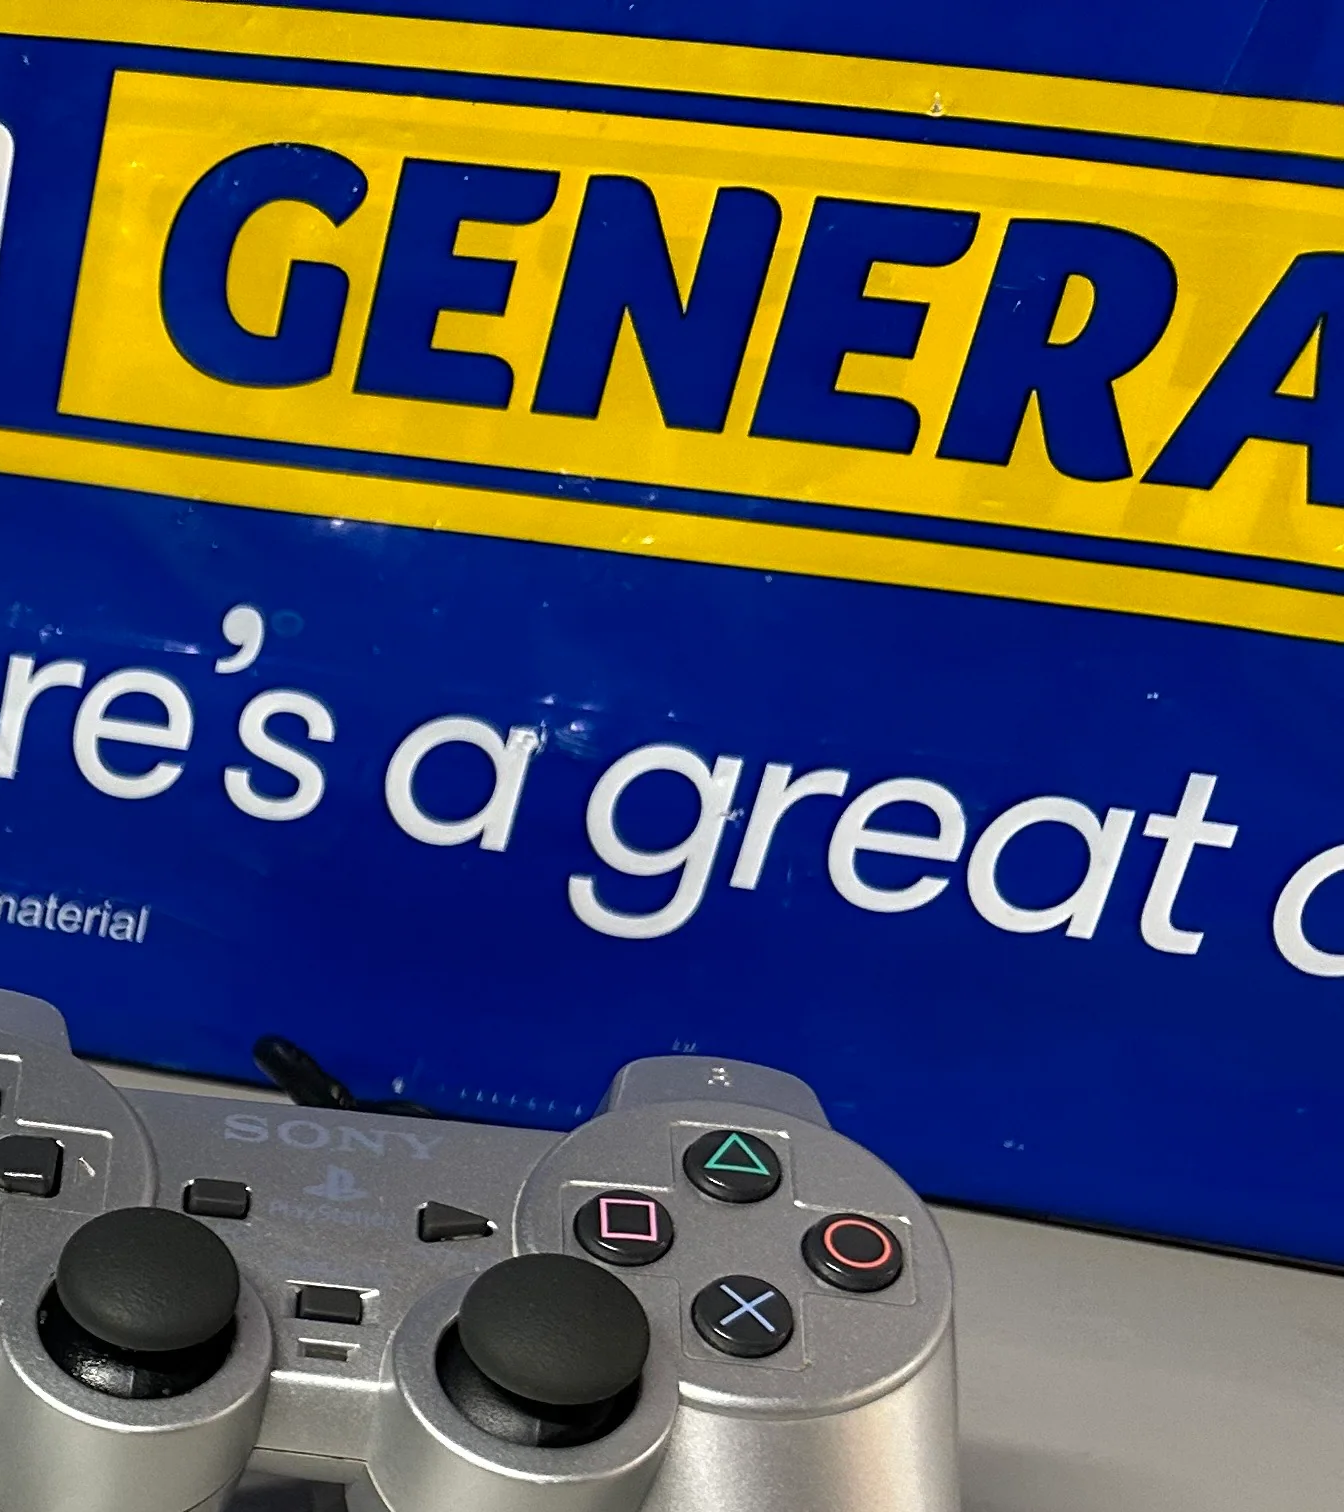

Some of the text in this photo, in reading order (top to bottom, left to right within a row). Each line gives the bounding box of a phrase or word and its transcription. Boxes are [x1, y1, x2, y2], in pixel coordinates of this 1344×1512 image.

[158, 141, 1344, 510] GENERA
[384, 715, 543, 852] a
[567, 743, 1239, 956] great
[223, 1112, 444, 1161] SONY
